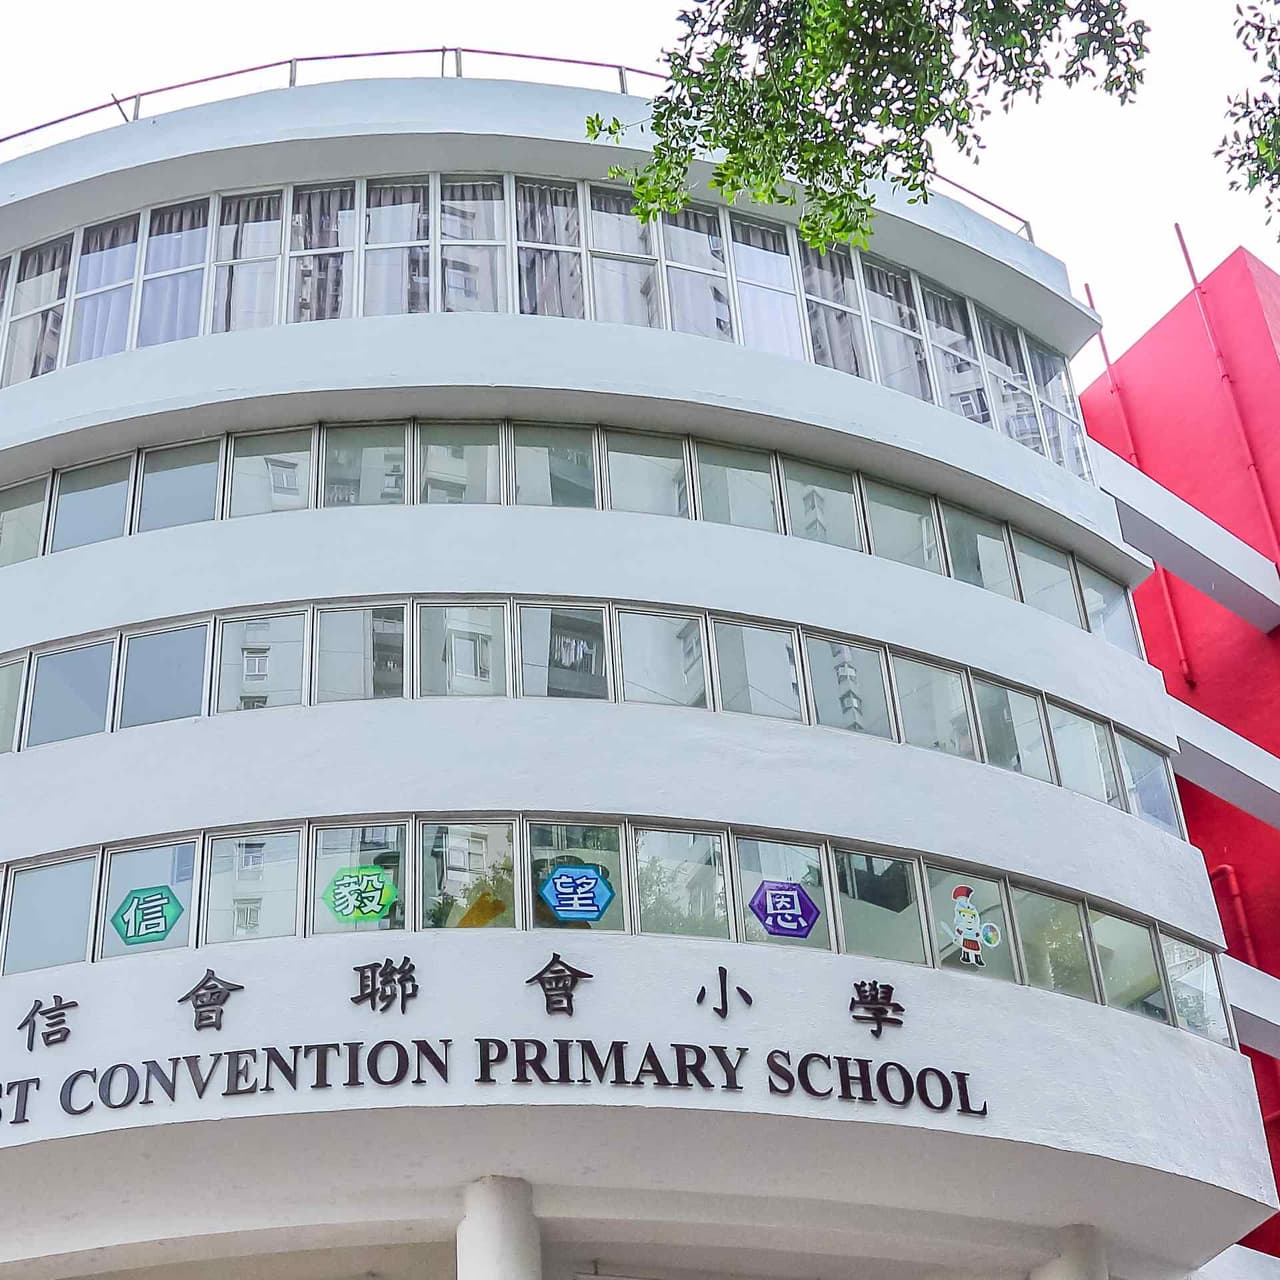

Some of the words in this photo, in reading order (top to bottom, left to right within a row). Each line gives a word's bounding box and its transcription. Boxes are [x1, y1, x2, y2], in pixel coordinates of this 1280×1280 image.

[120, 894, 171, 939] 信
[332, 872, 388, 920] 毅
[550, 873, 605, 917] 望
[765, 888, 808, 933] 恩
[59, 1038, 453, 1116] CONVENTION
[474, 1037, 750, 1091] PRIMARY
[767, 1049, 989, 1117] SCHOOL
